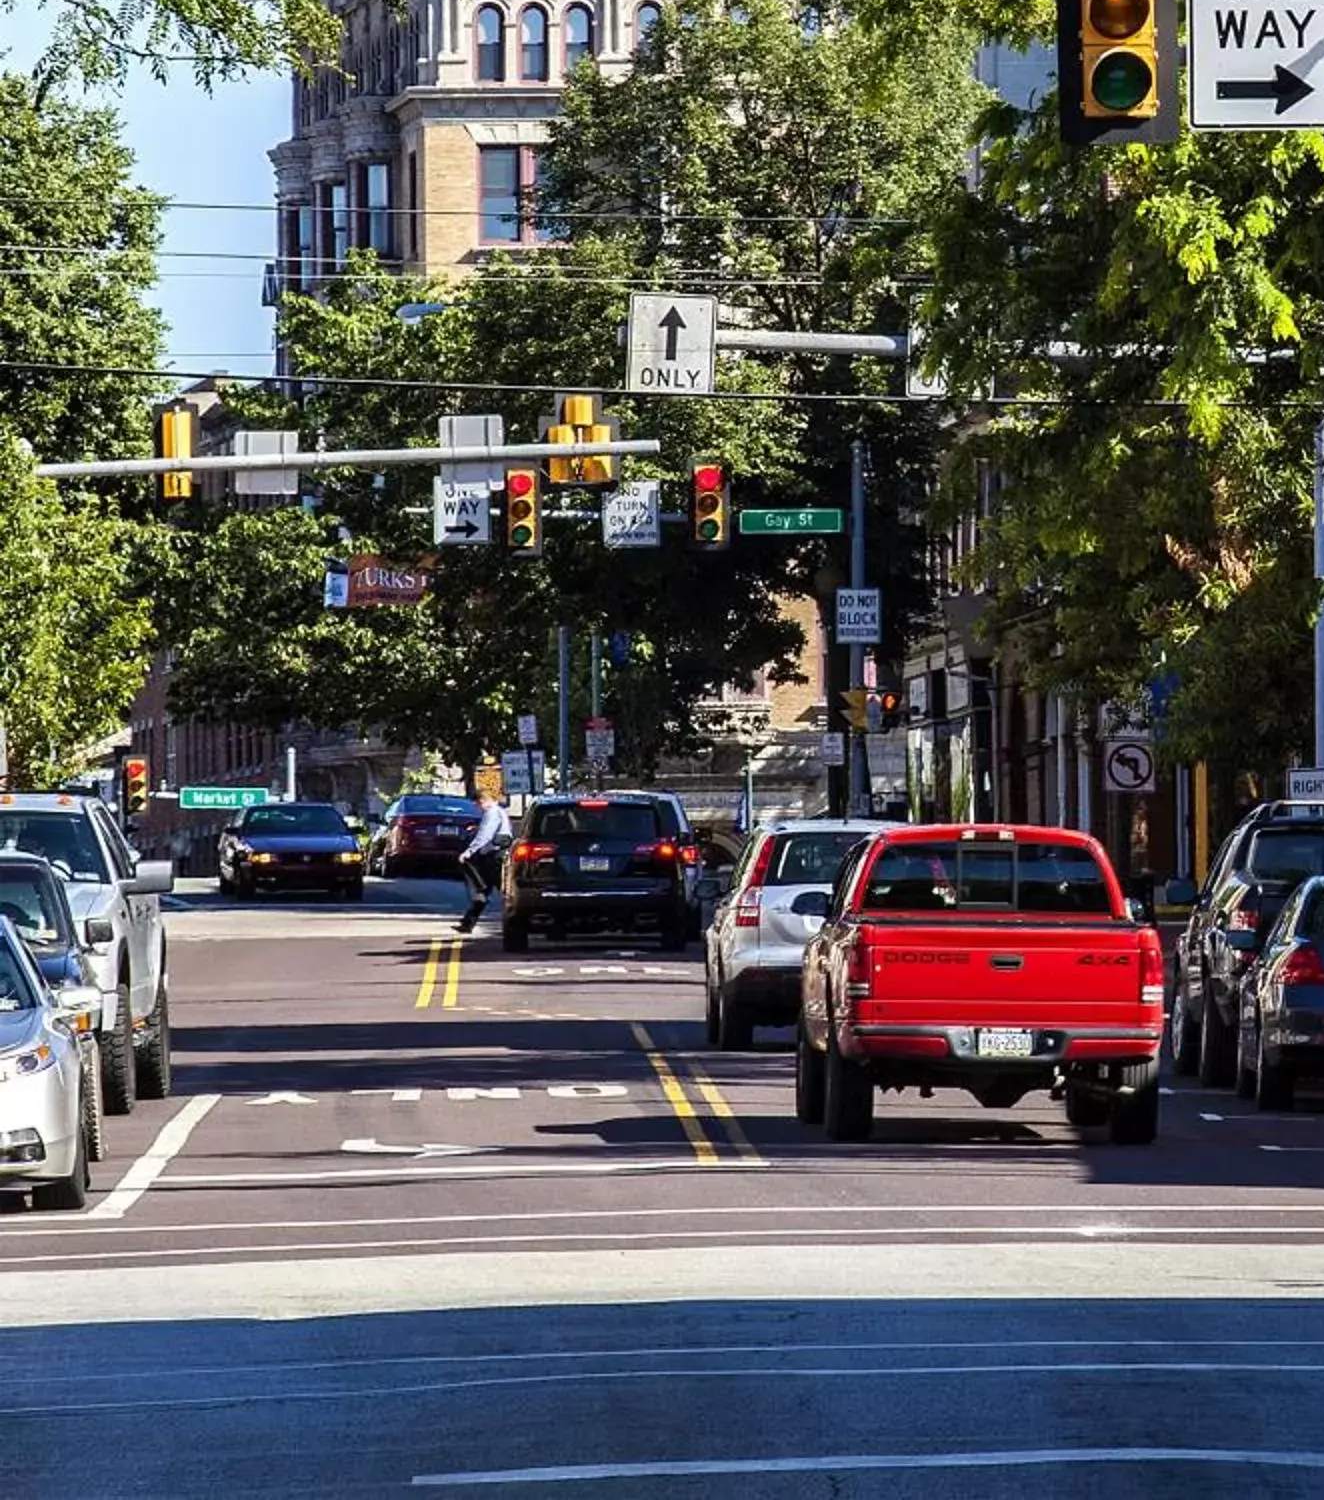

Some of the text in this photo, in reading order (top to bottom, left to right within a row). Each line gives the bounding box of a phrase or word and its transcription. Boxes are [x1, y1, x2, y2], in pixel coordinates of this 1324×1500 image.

[1215, 9, 1316, 49] WAY
[640, 367, 701, 389] ONLY
[443, 500, 480, 516] WAY
[765, 513, 814, 528] Gay St
[839, 595, 855, 607] DO
[839, 611, 877, 625] BLOCK
[193, 791, 237, 805] Market
[884, 953, 970, 965] DODGE
